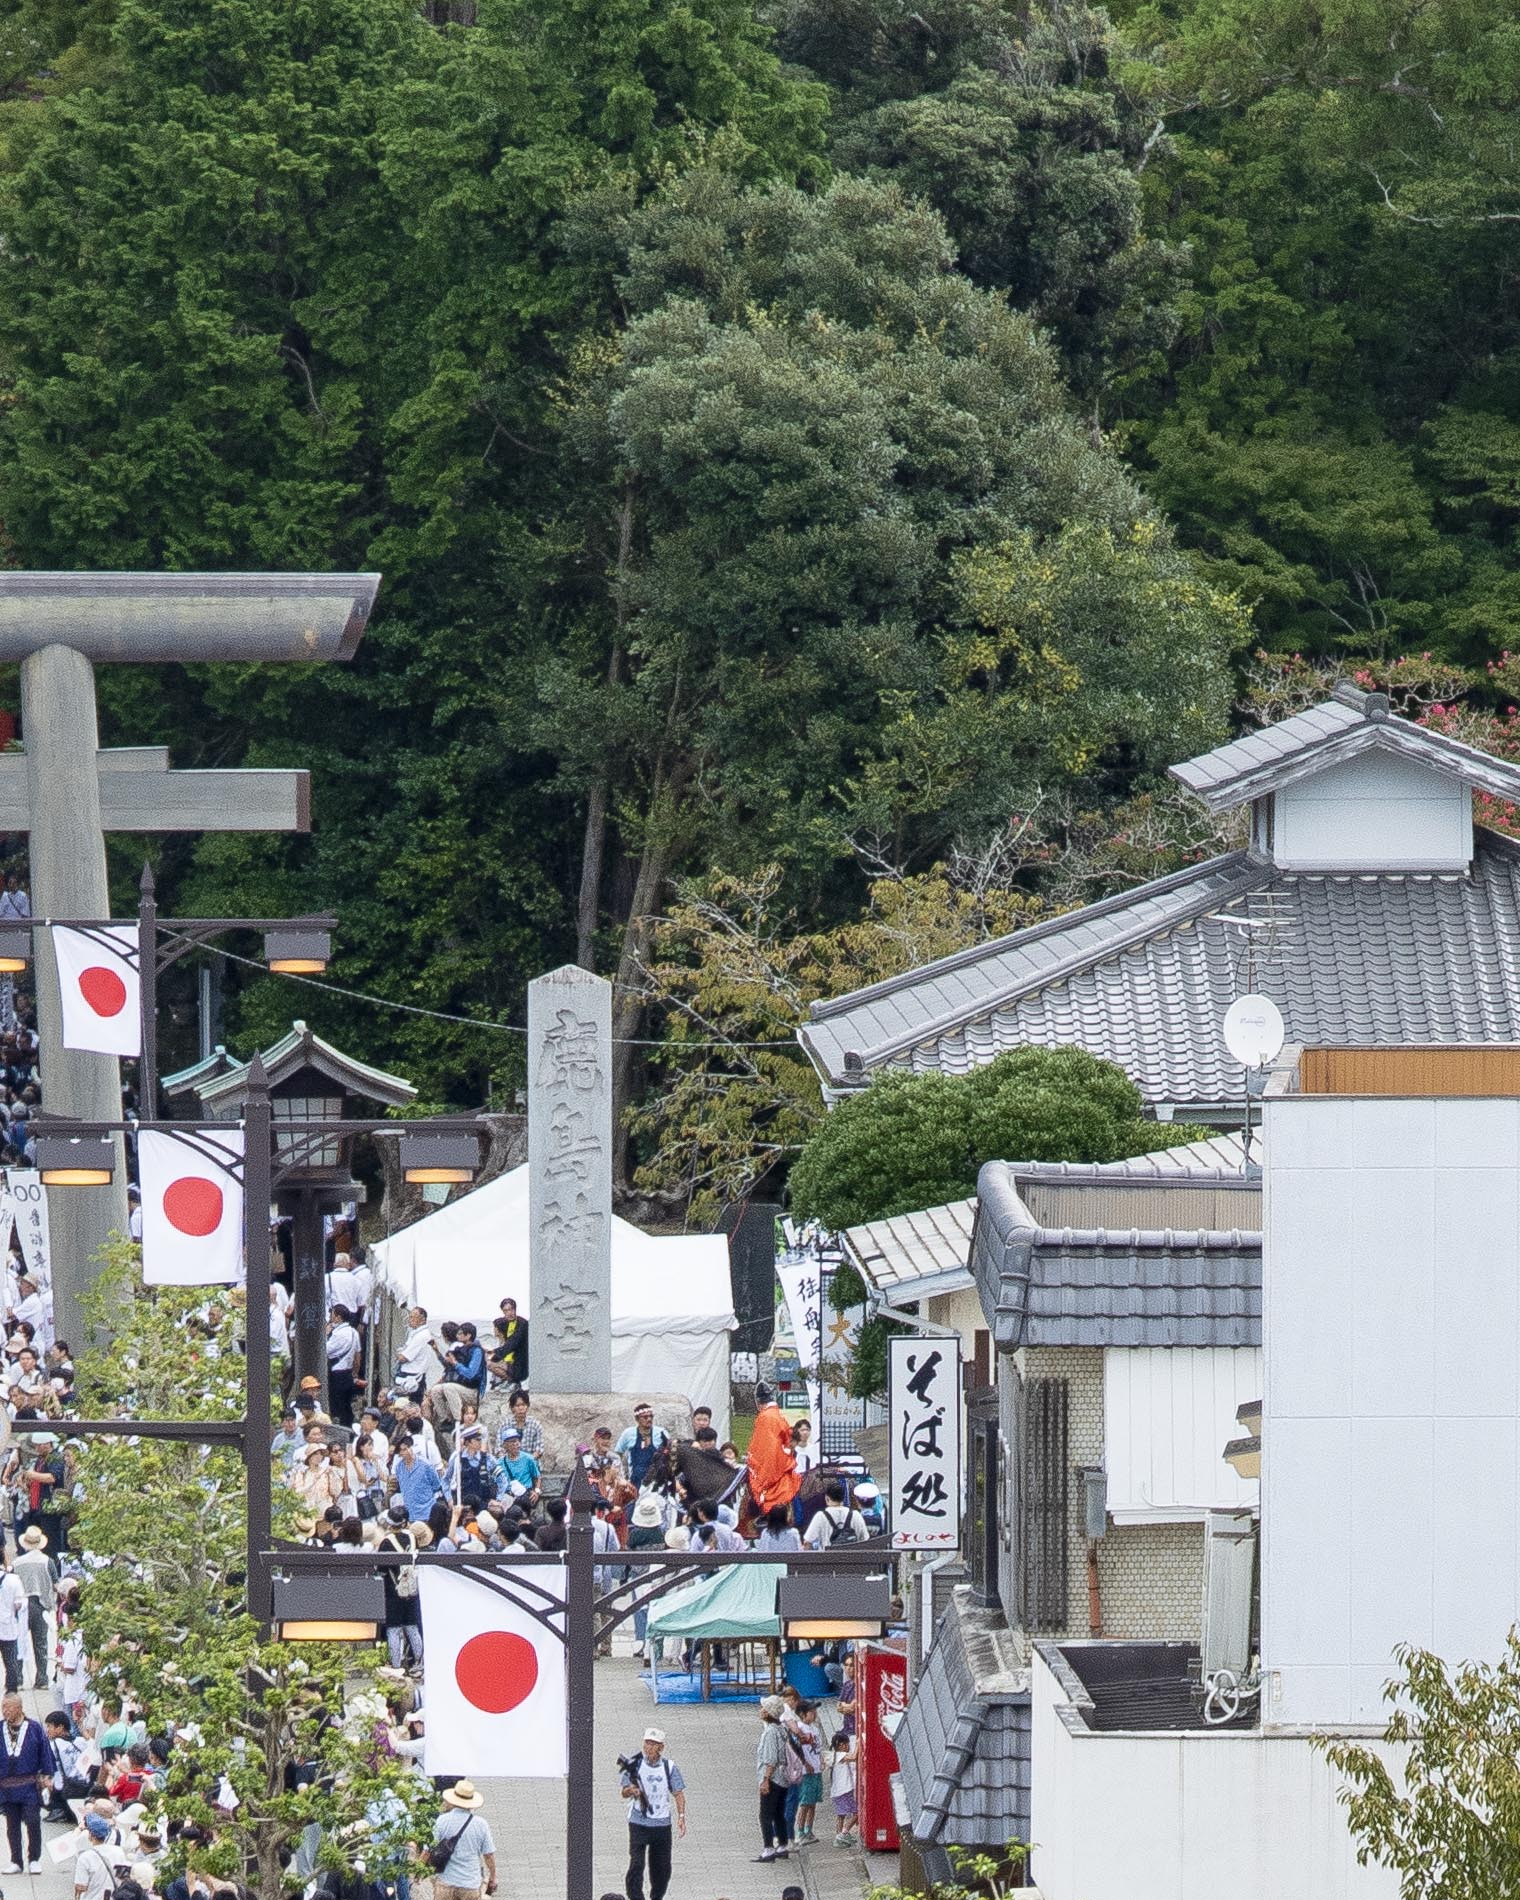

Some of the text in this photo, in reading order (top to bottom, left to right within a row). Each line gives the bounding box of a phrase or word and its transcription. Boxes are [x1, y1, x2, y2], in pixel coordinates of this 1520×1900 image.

[536, 1009, 604, 1360] 鹿島神宮
[899, 1350, 948, 1517] そば処
